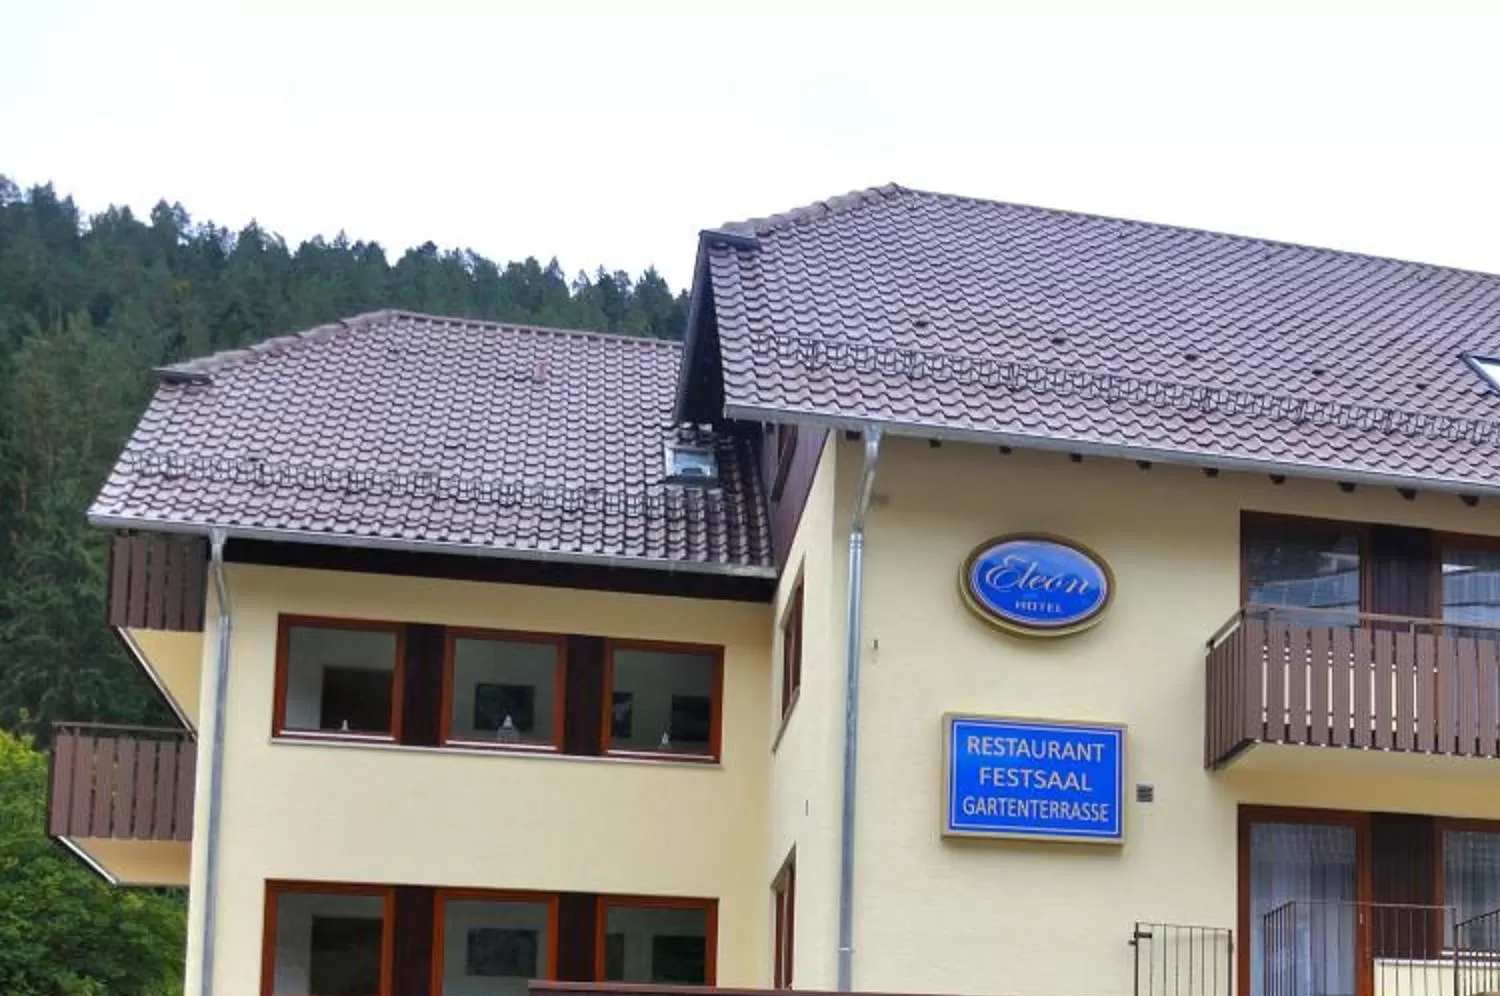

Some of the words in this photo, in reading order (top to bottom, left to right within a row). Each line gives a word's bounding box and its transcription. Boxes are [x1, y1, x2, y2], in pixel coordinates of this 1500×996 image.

[966, 735, 1105, 763] RESTAURANT
[979, 767, 1093, 792] FESTSAAL
[962, 796, 1109, 822] GARTENTERRASSE
